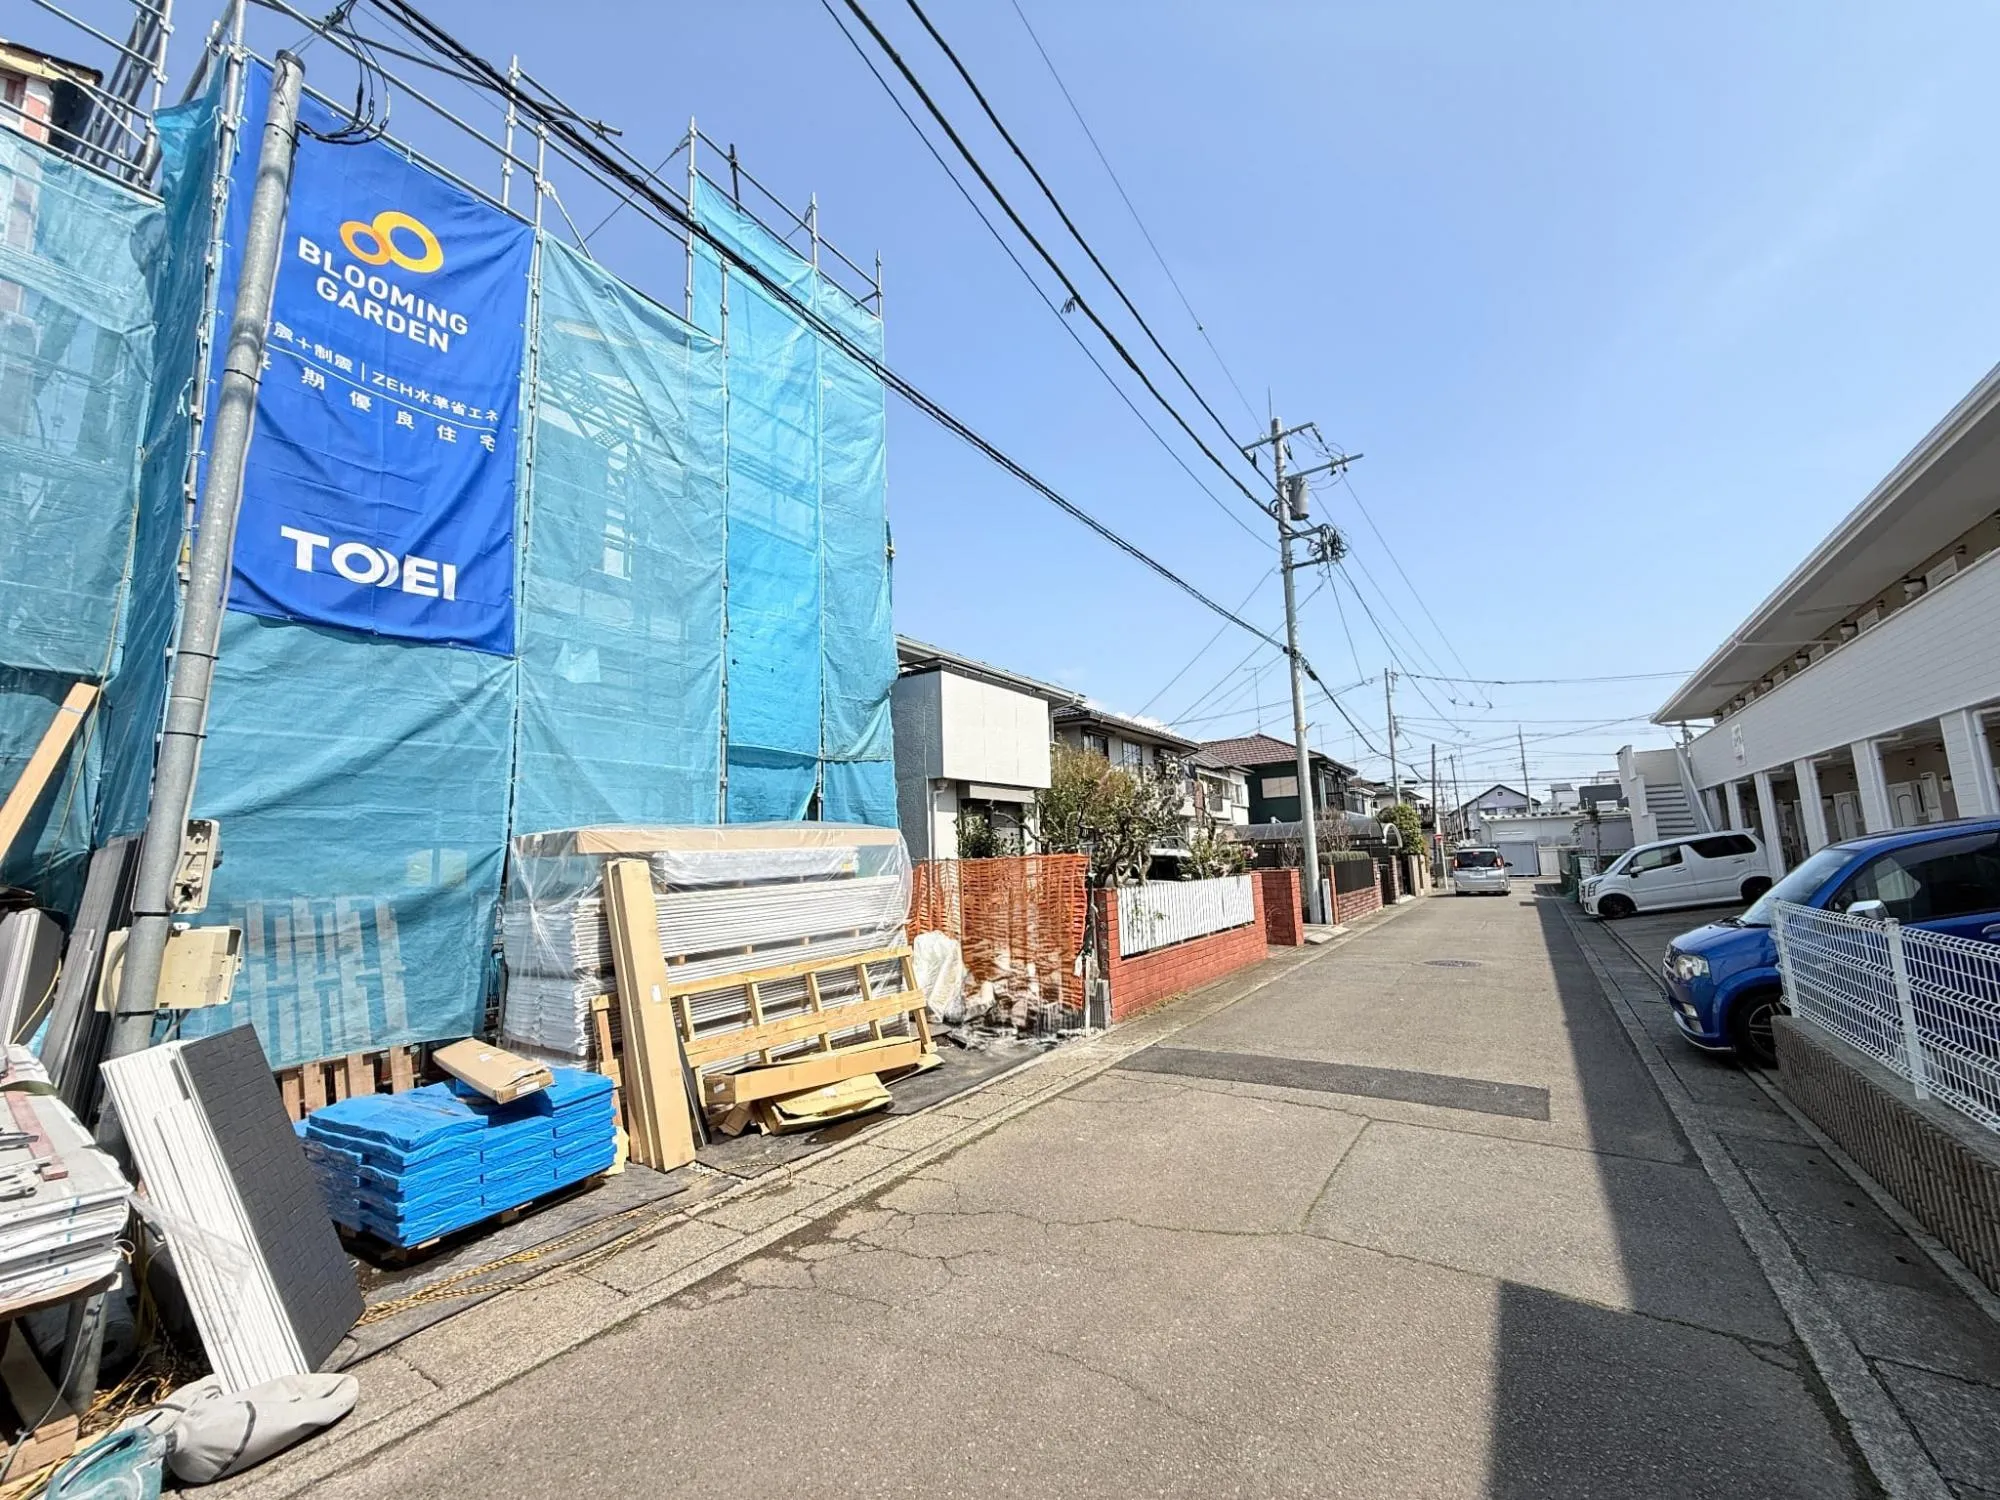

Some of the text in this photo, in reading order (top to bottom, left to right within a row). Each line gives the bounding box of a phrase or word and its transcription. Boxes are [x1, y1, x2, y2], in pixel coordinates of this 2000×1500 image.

[298, 236, 469, 336] BLOOMING
[316, 277, 450, 353] GARDEN
[280, 524, 457, 601] TOEI
